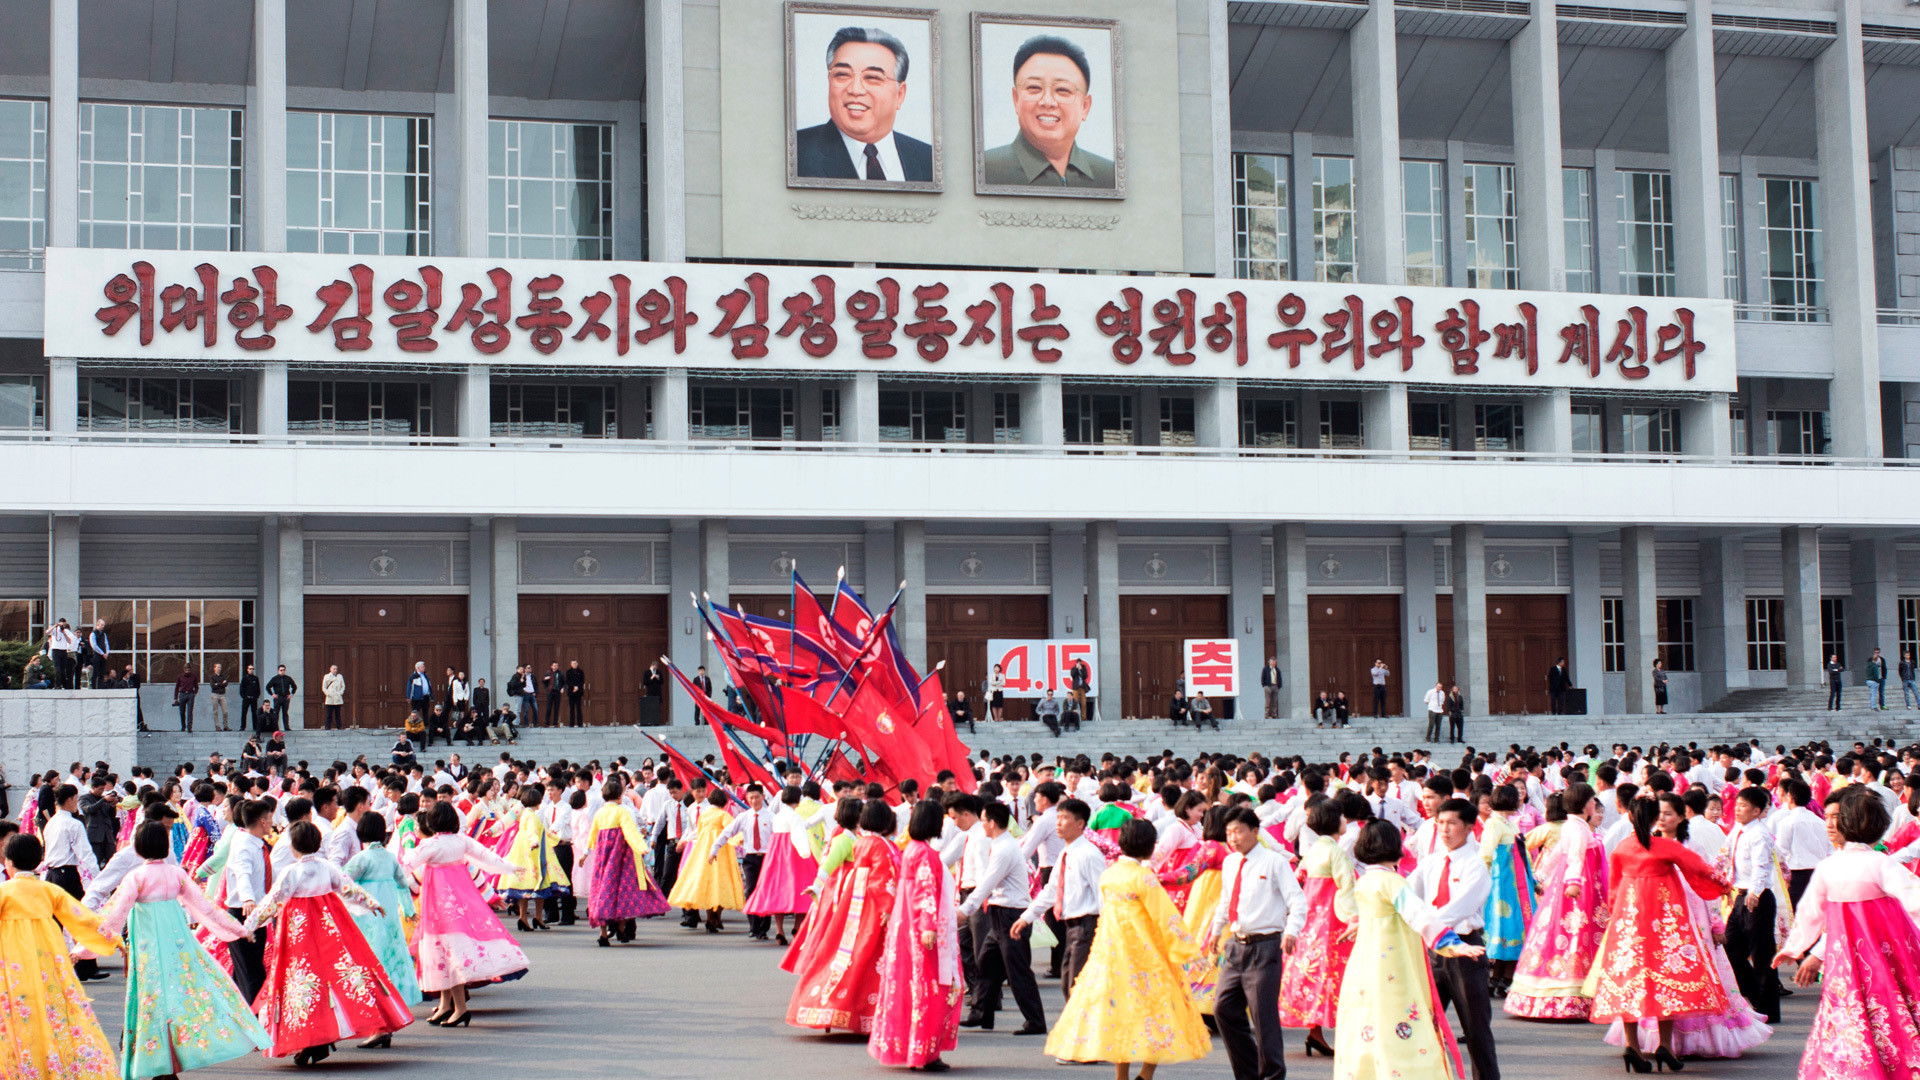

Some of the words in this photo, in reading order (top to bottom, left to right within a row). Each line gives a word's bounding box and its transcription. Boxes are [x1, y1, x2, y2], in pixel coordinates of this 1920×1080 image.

[96, 260, 293, 349] 위대한
[307, 264, 698, 355] 김일성동지와
[709, 271, 1069, 362] 김정일동지는
[1096, 288, 1248, 366] 영원히
[1268, 293, 1424, 371] 우리와
[1436, 299, 1538, 375] 함께
[1558, 304, 1705, 380] 계신다
[999, 644, 1093, 692] 4.15
[1191, 641, 1233, 692] 축
